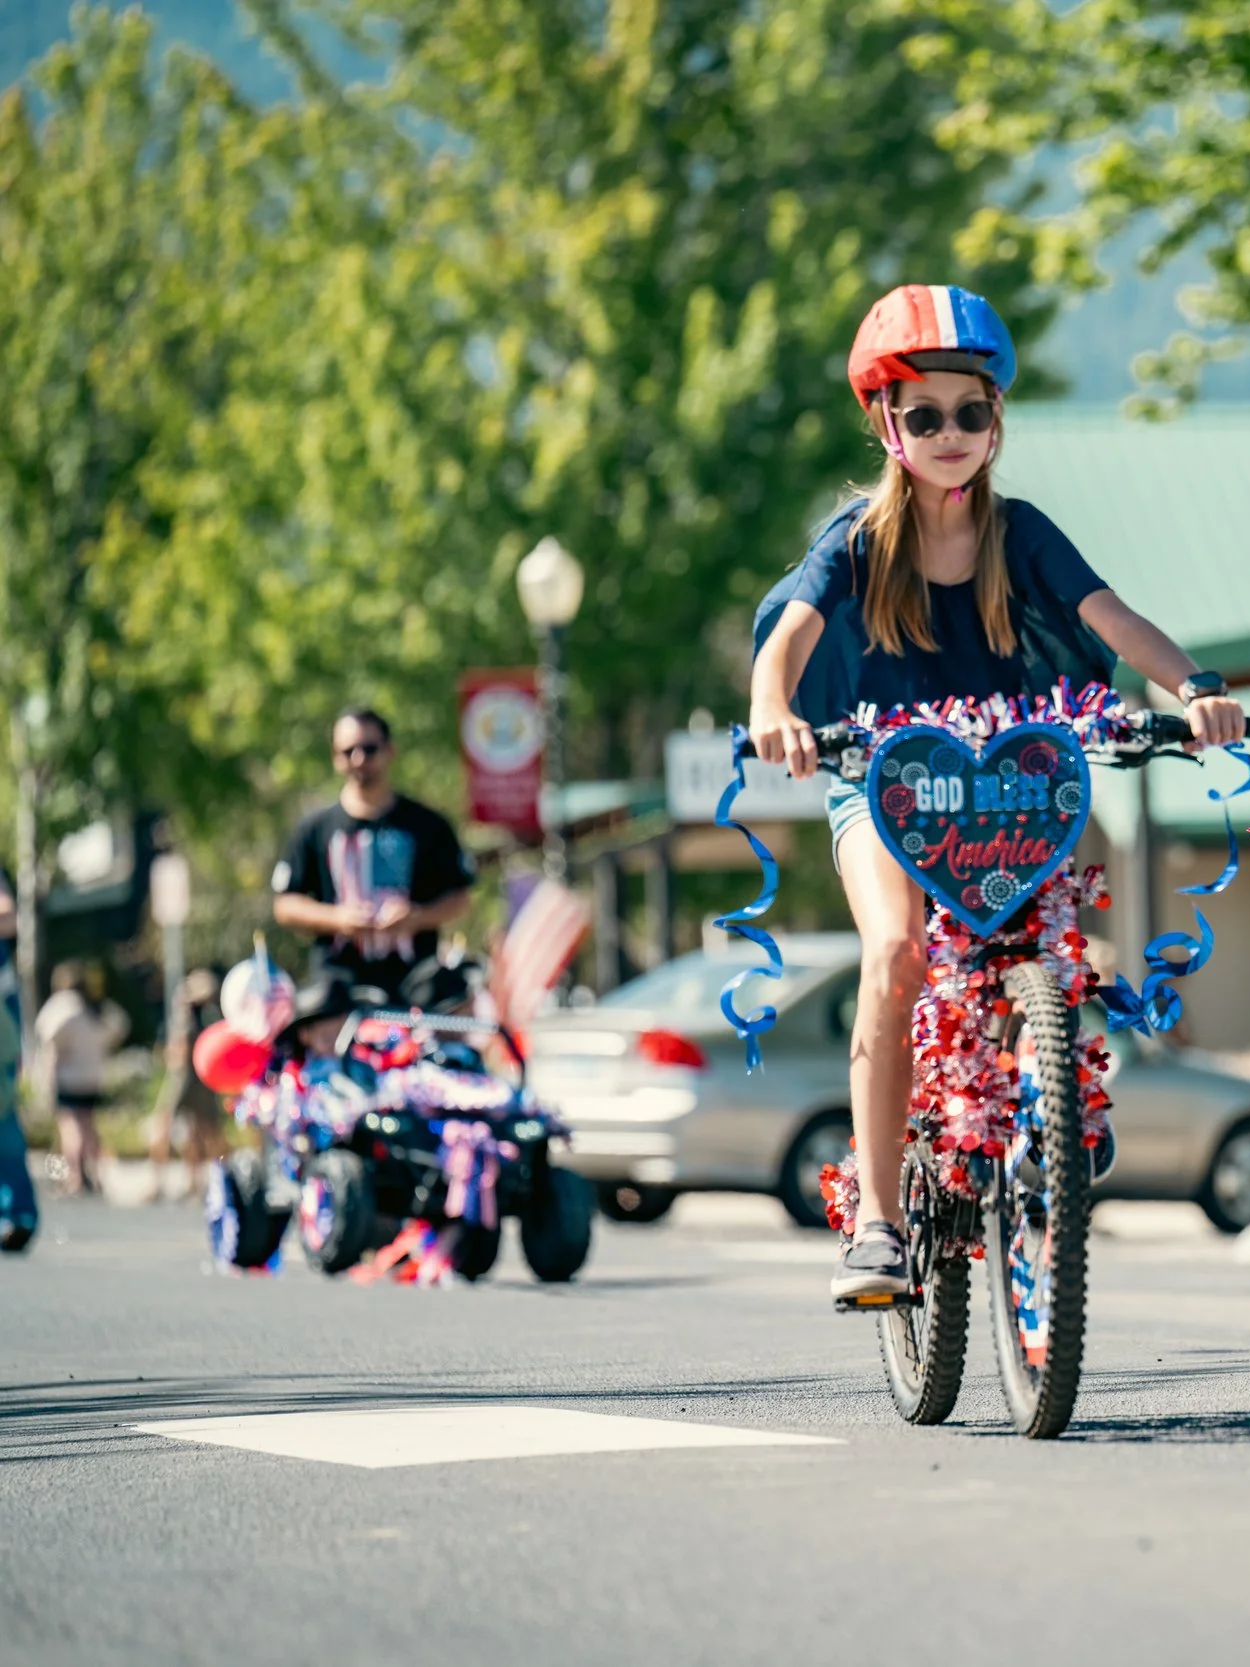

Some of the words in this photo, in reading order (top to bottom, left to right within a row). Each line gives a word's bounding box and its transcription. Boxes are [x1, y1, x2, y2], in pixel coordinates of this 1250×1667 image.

[915, 776, 964, 813] GOD
[974, 774, 1050, 812] BLESS
[916, 823, 1055, 880] America
